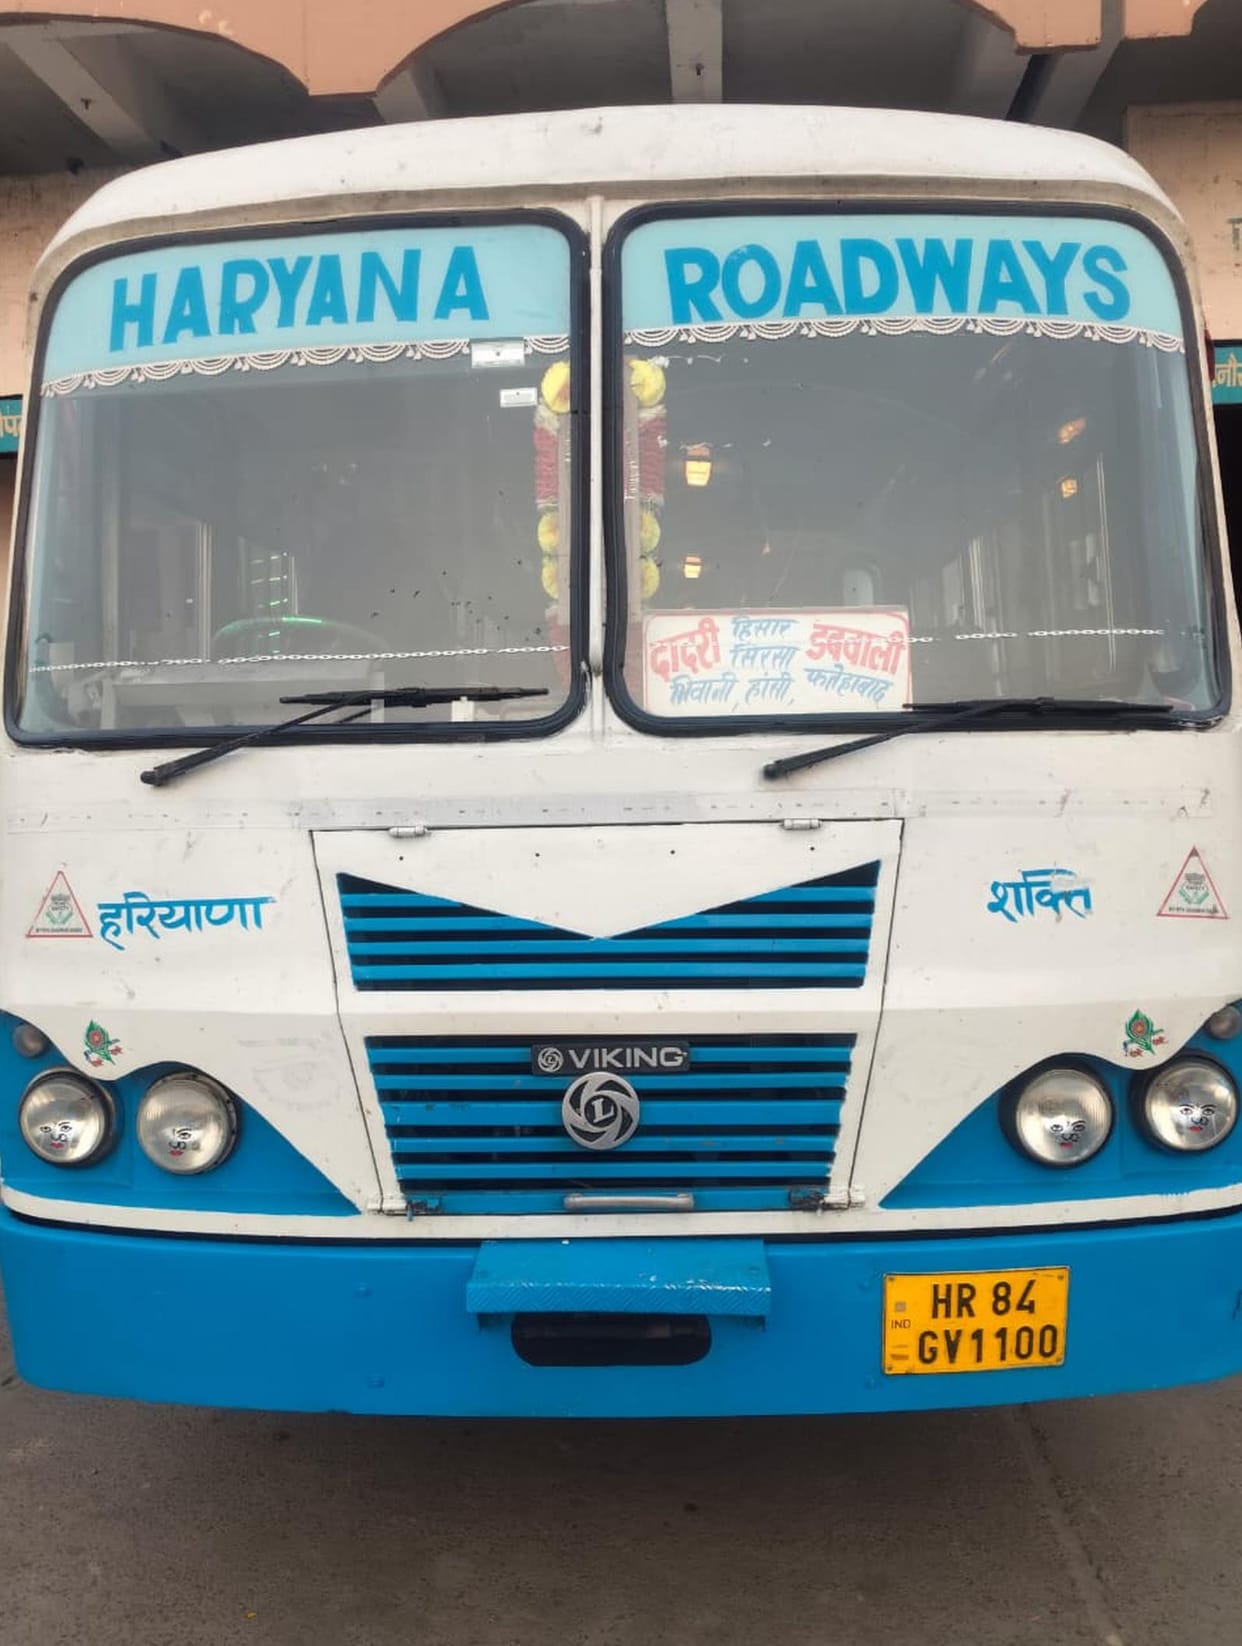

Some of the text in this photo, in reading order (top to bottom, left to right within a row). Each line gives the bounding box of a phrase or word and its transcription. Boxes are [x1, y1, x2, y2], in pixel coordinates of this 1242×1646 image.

[109, 238, 1131, 352] HARYANA ROADWAYS
[730, 616, 800, 641] हिसार
[649, 617, 721, 682] दादरी
[729, 643, 801, 669] सिरसा
[987, 869, 1093, 923] शक्ति
[97, 891, 277, 950] हरियाणा
[568, 1047, 688, 1069] VIKING
[931, 1279, 1036, 1319] HR 84
[891, 1319, 911, 1329] IND
[918, 1324, 1058, 1364] GV1100
